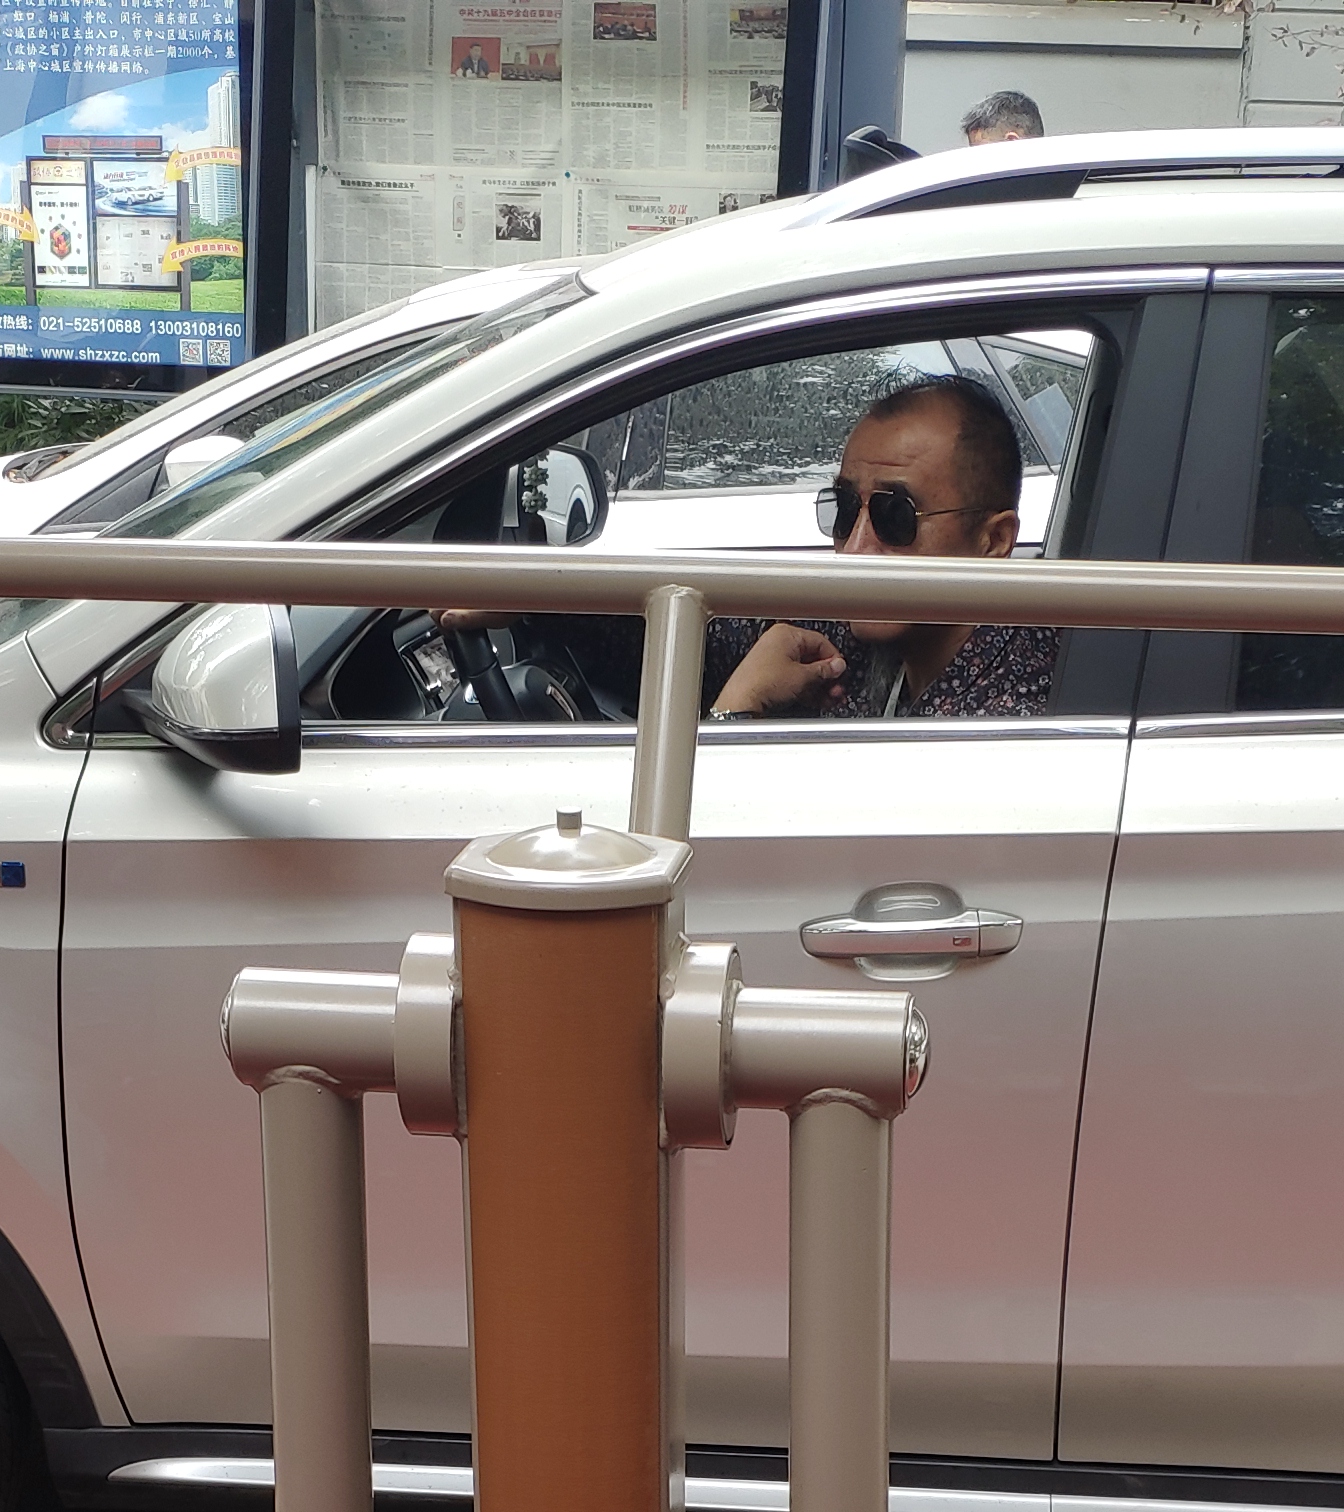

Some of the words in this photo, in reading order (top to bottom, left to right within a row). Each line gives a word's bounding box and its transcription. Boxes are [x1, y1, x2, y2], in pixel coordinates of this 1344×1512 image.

[40, 318, 142, 334] 021-52510688
[150, 320, 242, 338] 13003108160
[41, 346, 160, 363] www.shzxzc.com
